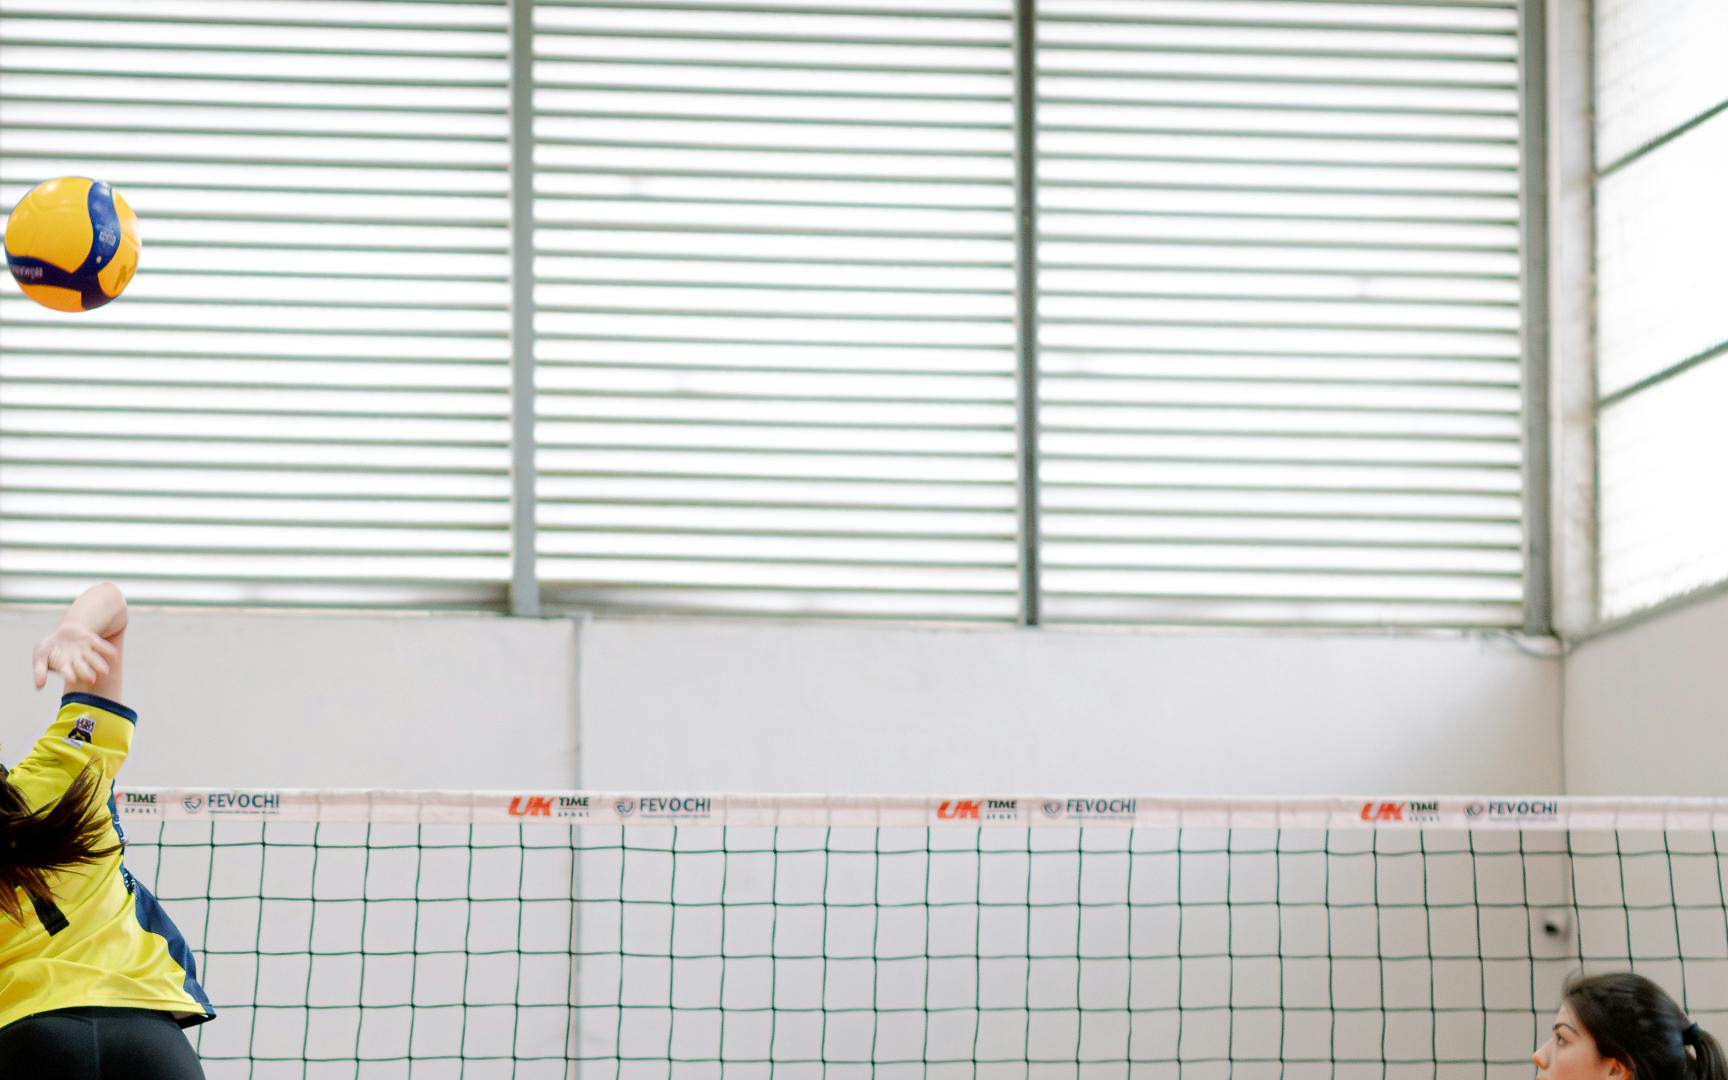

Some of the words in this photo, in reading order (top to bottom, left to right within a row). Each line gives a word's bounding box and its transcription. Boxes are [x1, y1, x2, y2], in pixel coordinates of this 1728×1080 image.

[125, 793, 157, 804] TIME
[208, 794, 279, 808] FEVOCHI
[559, 797, 589, 806] TIME
[640, 798, 710, 812] FEVOCHI
[987, 800, 1017, 809] TIME
[508, 796, 555, 816] UK
[1066, 799, 1136, 813] FEVOCHI
[1488, 801, 1557, 815] FEVOCHI
